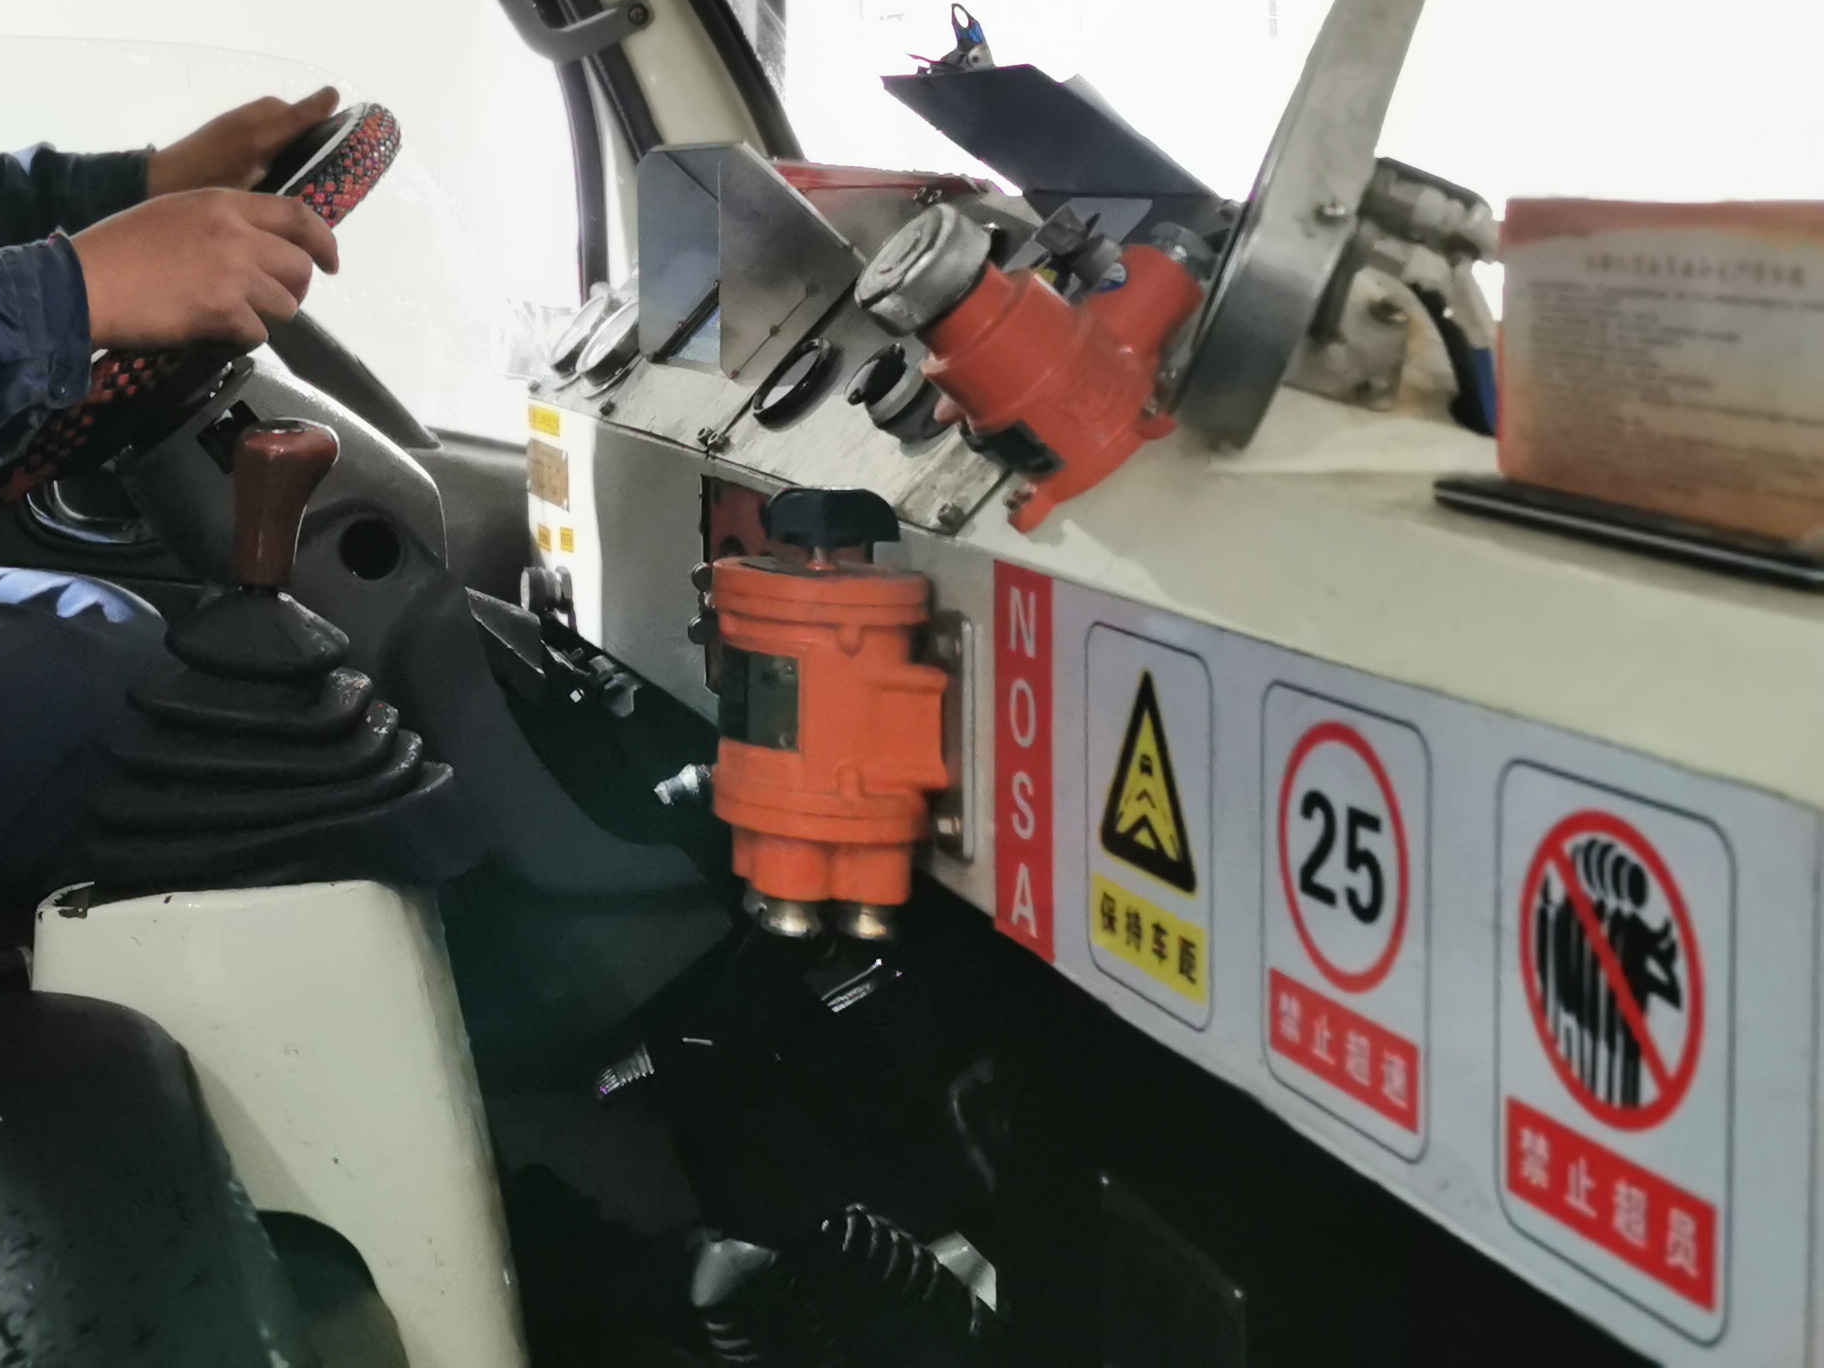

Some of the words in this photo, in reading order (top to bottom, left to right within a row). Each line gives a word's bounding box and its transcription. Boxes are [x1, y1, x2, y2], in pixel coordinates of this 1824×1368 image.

[1009, 585, 1037, 939] NOSA
[1299, 788, 1385, 925] 25
[1279, 991, 1408, 1110] 禁止超速
[1519, 1127, 1699, 1279] 禁止超员
